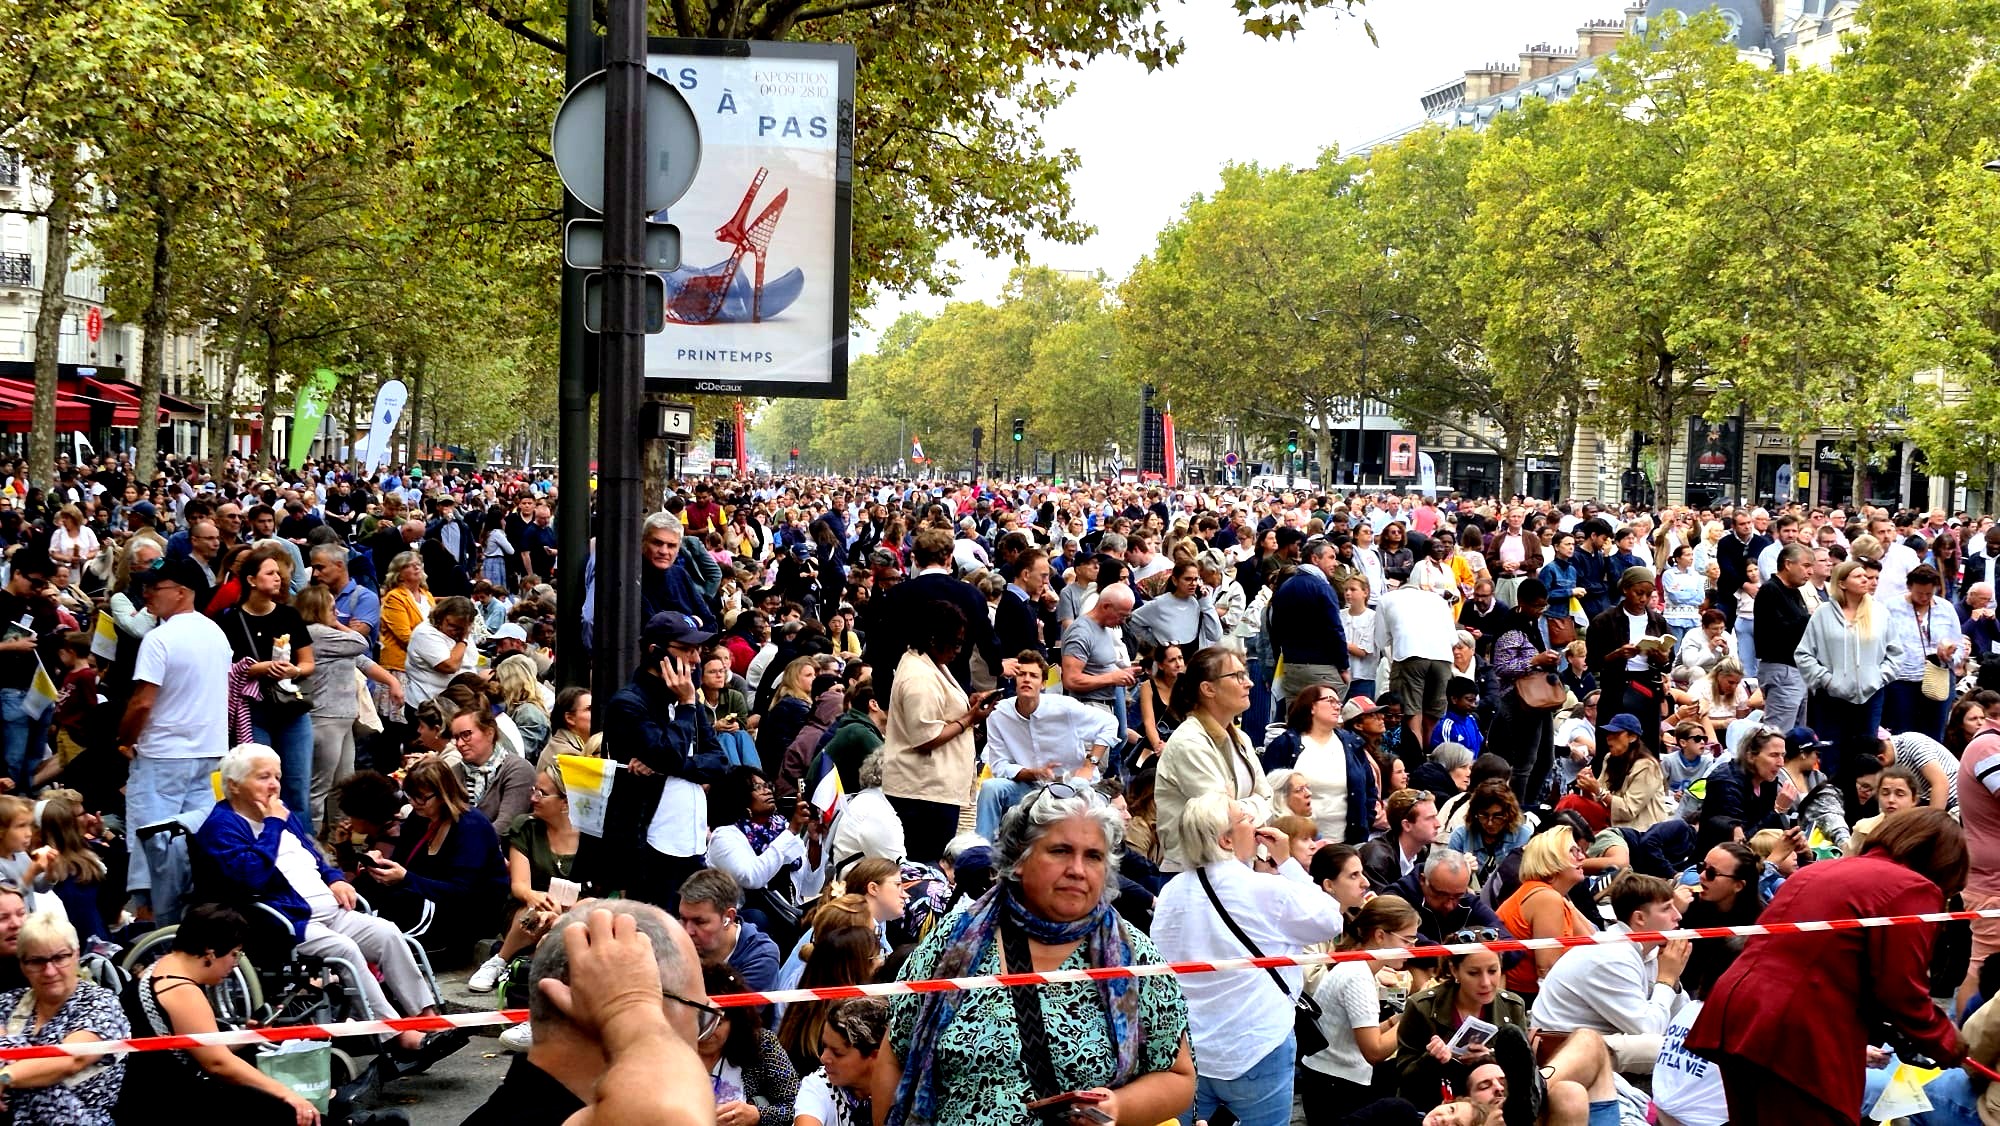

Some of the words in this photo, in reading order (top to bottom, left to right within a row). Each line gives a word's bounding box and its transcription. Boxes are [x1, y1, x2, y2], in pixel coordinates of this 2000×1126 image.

[656, 67, 698, 90] AS
[755, 71, 828, 84] EXPOSITION
[717, 88, 738, 114] À
[758, 115, 828, 139] PAS
[677, 349, 773, 363] PRINTEMPS
[695, 381, 742, 392] JCDecaux
[673, 413, 680, 427] 5
[1668, 1024, 1690, 1039] OUR
[1667, 1053, 1681, 1070] LA
[1685, 1059, 1707, 1079] VIE
